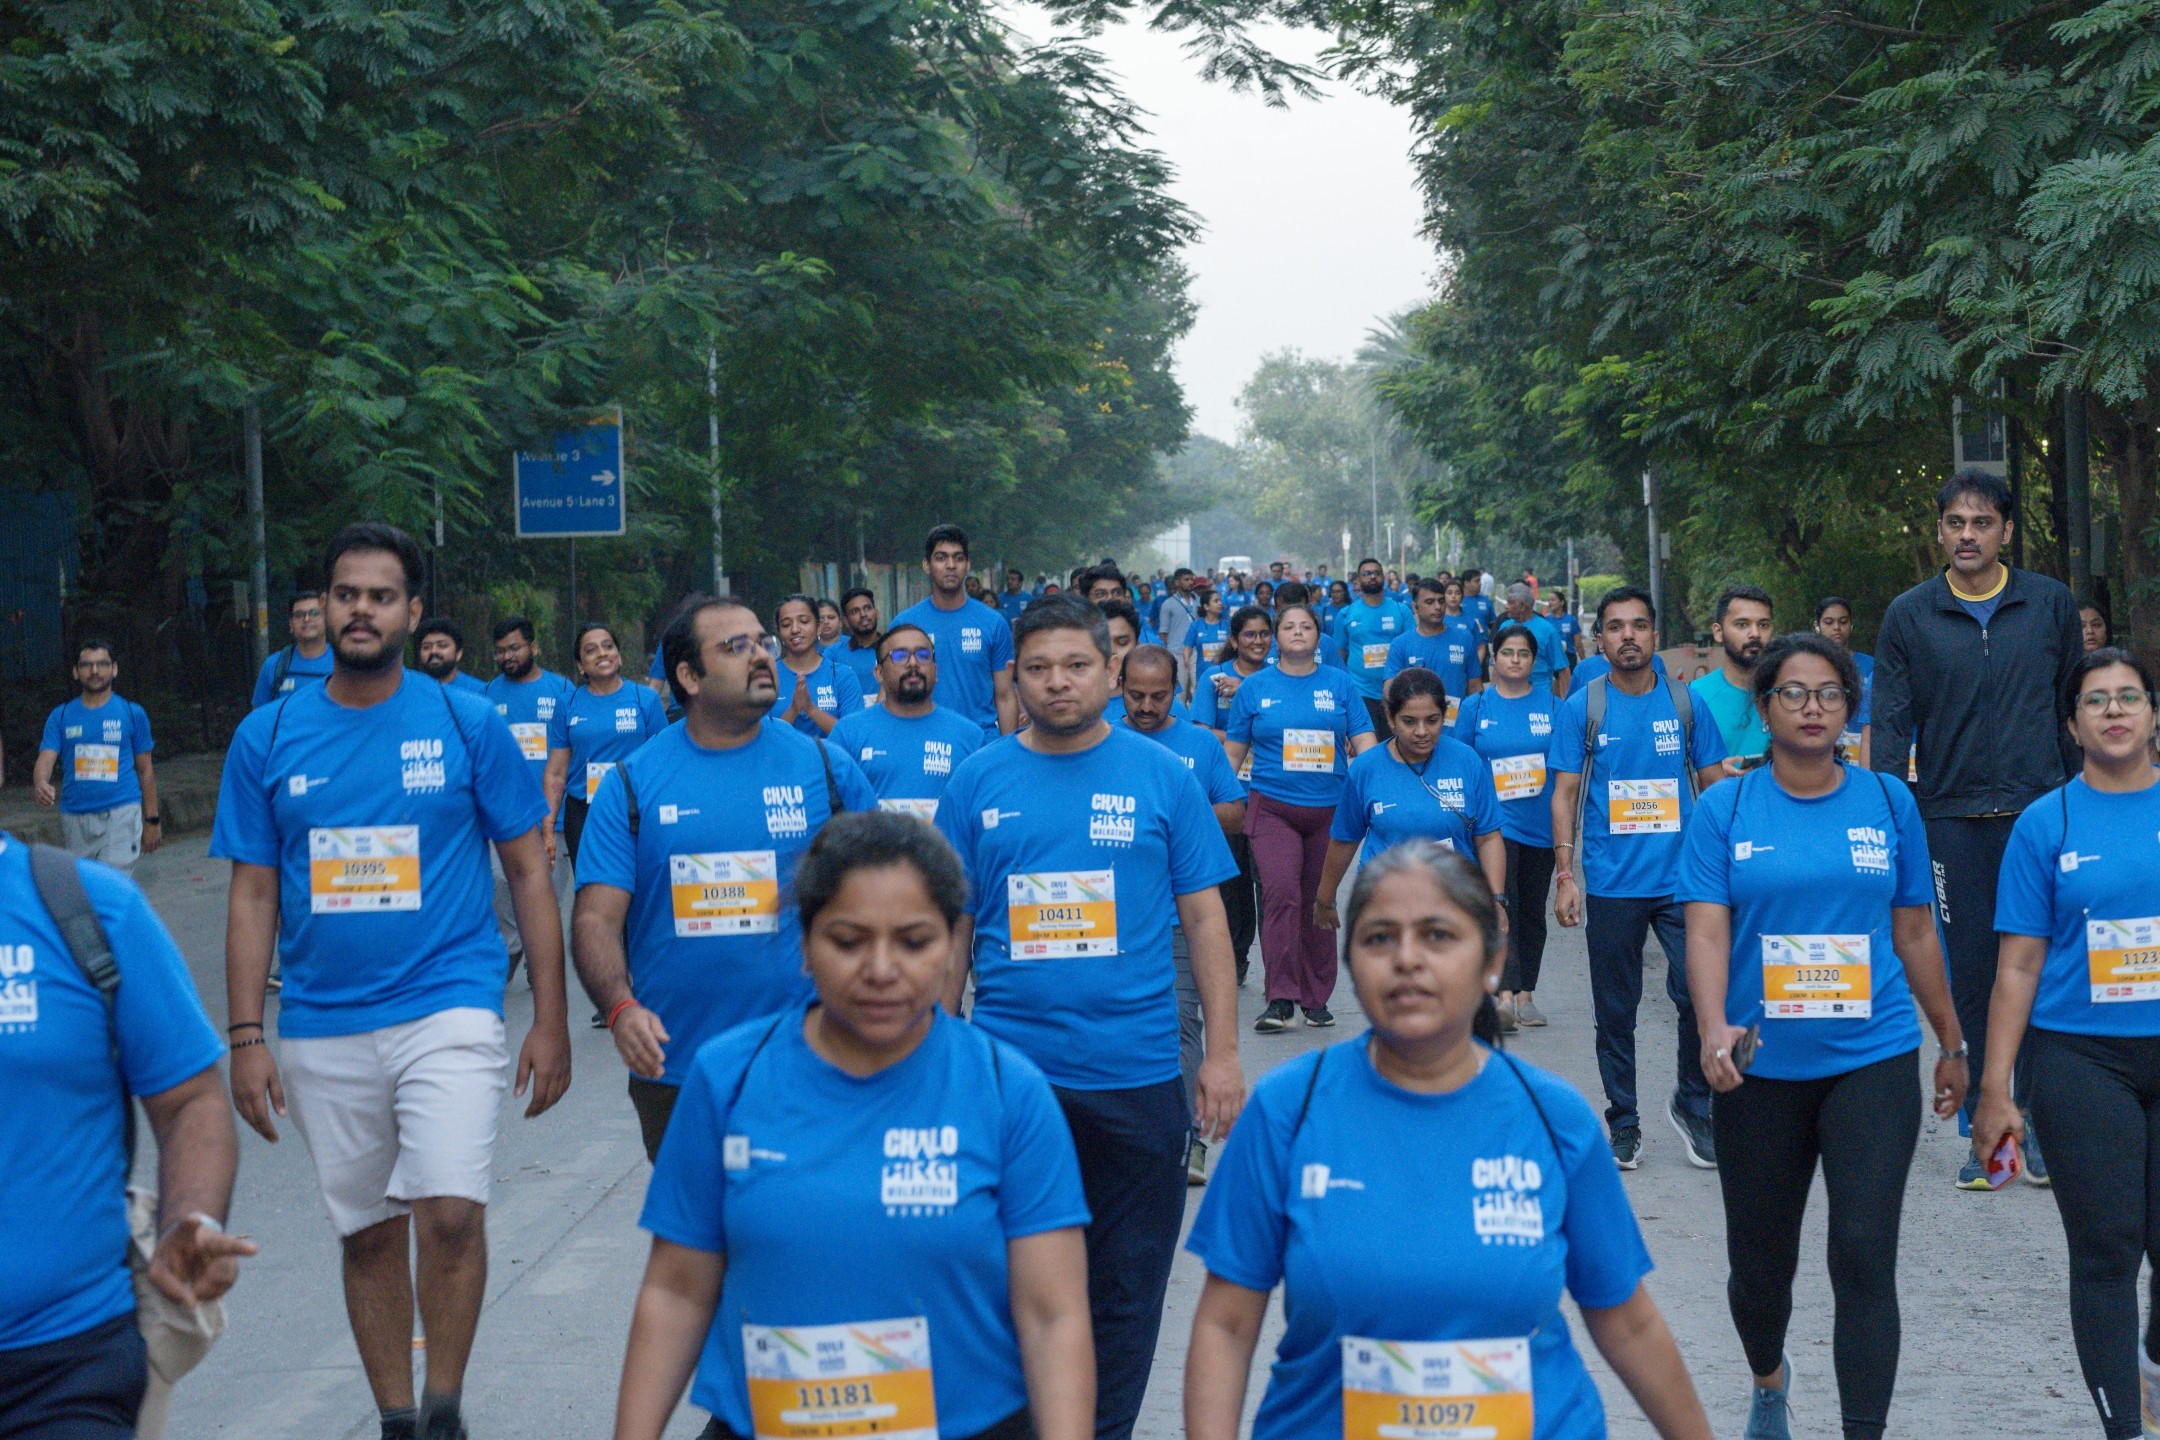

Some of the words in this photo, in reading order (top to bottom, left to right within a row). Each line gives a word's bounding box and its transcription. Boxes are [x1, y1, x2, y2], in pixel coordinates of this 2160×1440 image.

[571, 449, 581, 462] 3
[521, 496, 563, 509] Avenue
[566, 496, 575, 508] 5
[579, 496, 606, 508] Lane
[607, 494, 616, 507] 3
[817, 685, 833, 697] CHAL
[1653, 719, 1678, 735] CHALO
[925, 740, 952, 757] CHALO
[763, 785, 804, 807] CHALO
[1091, 793, 1136, 815] CHALO
[1631, 801, 1658, 811] 10256
[1092, 828, 1132, 838] WALKATHON
[703, 885, 746, 901] 10388
[1932, 859, 1951, 924] CYBER
[1038, 907, 1083, 922] 10411
[2123, 951, 2160, 966] 1123
[1796, 969, 1840, 982] 11220
[883, 1126, 959, 1160] CHALO
[1472, 1155, 1542, 1192] CHALO
[801, 1383, 874, 1408] 11181
[1400, 1402, 1476, 1425] 11097
